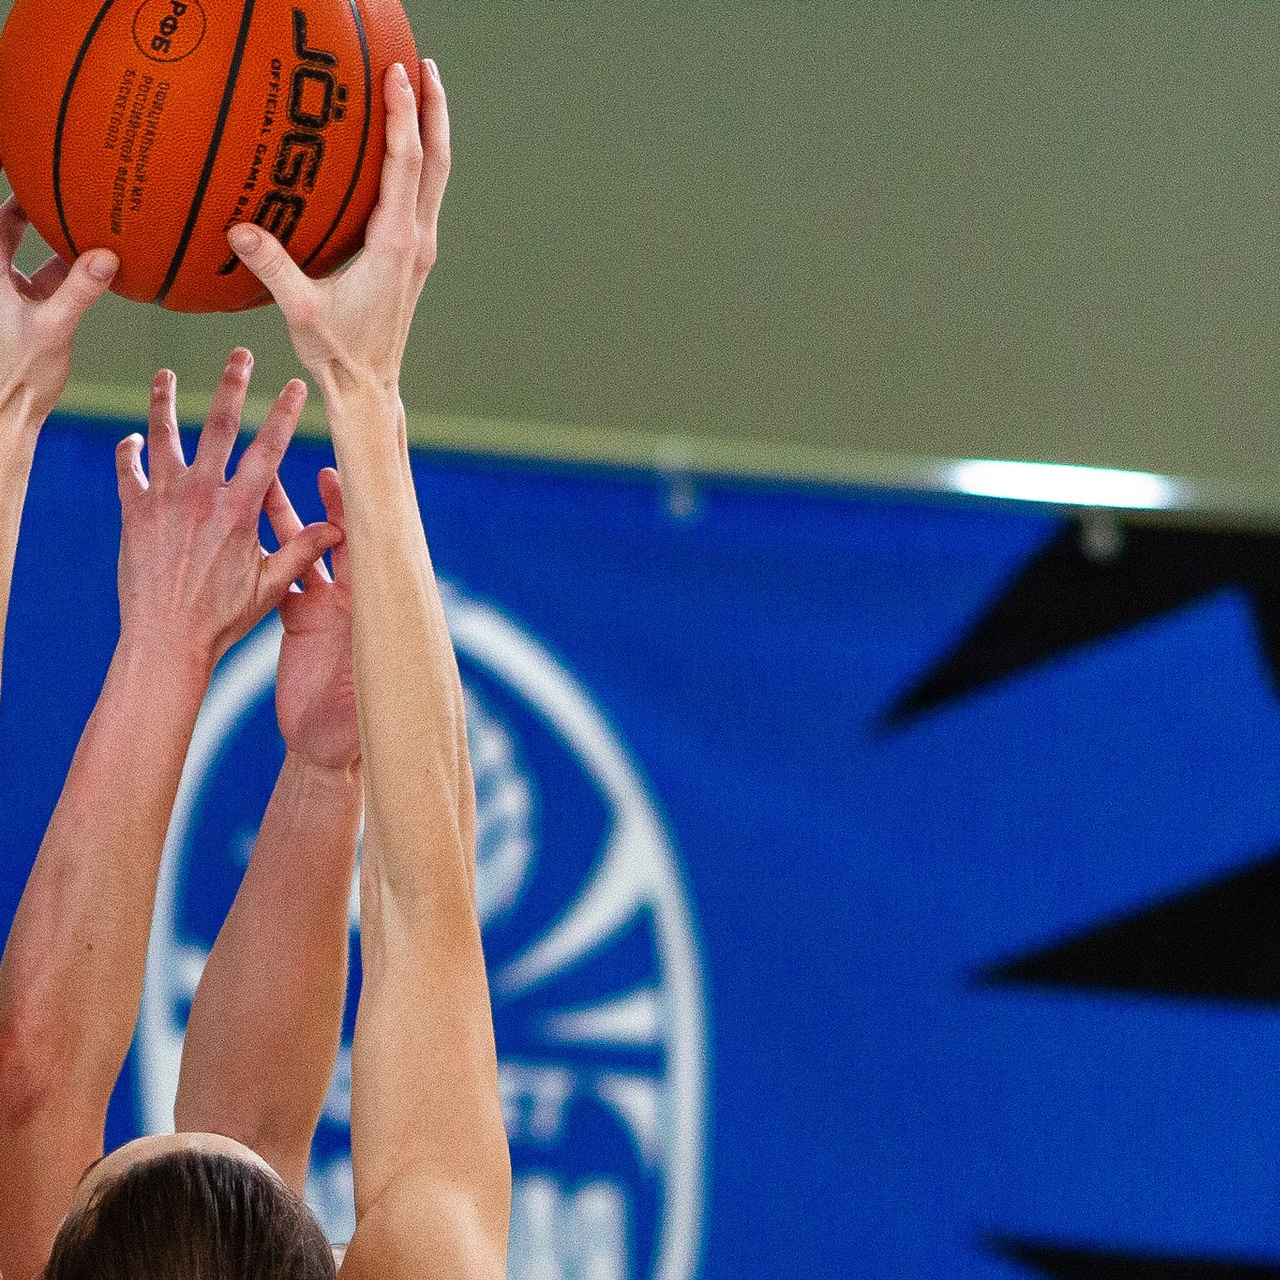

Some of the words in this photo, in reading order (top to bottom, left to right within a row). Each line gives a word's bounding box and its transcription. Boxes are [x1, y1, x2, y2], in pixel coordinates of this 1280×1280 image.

[151, 0, 188, 54] РФБ
[104, 68, 137, 151] БАСКЕТБОЛА
[120, 75, 155, 164] РОССИЙСКОЙ
[134, 81, 171, 183] ОФИЦИАЛЬНЫЙ
[260, 58, 283, 138] OFFICIAL
[217, 6, 350, 276] JÖGE
[242, 142, 267, 191] GAME
